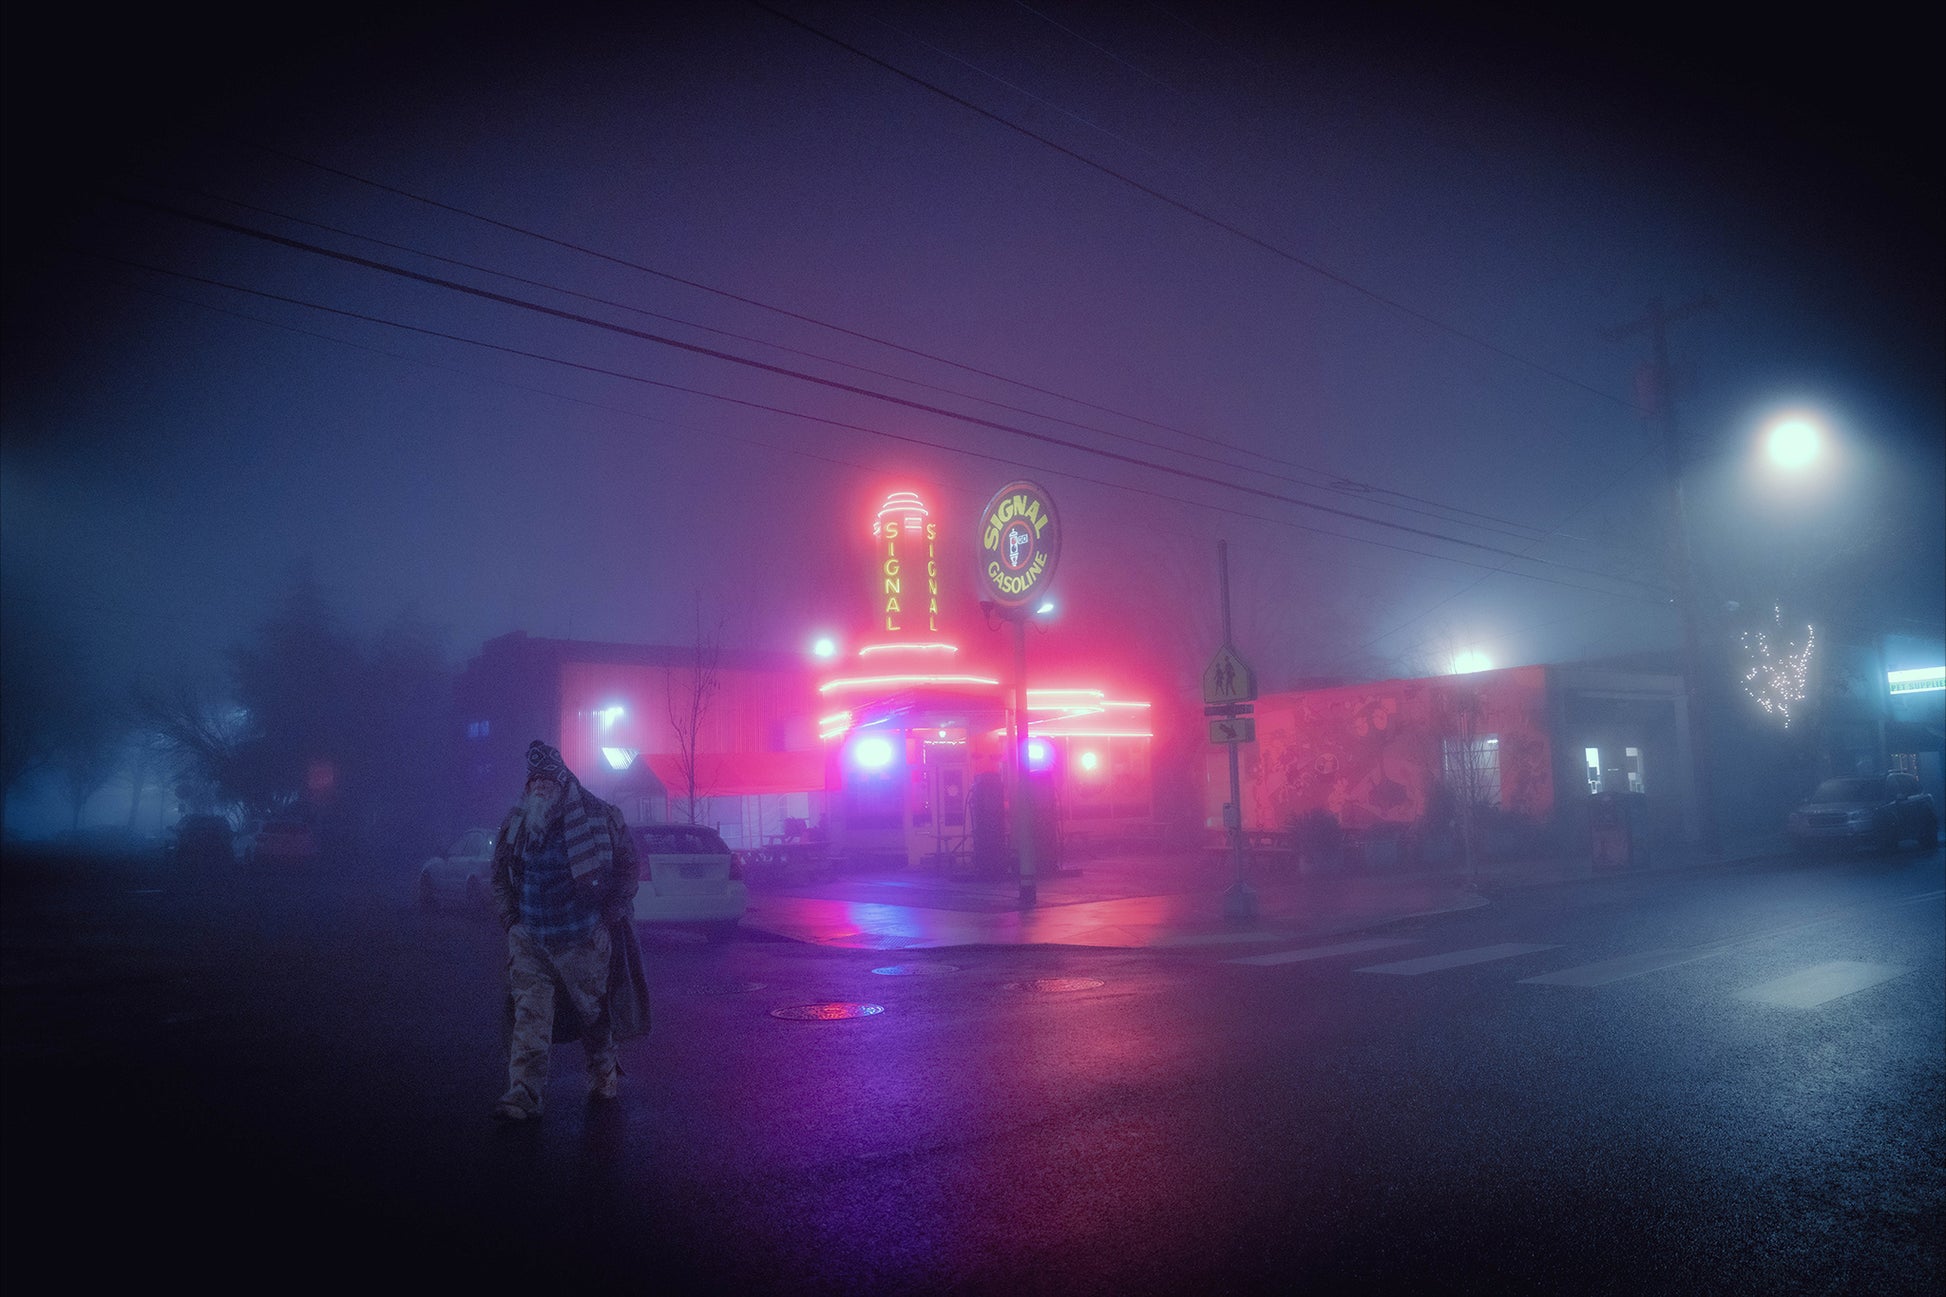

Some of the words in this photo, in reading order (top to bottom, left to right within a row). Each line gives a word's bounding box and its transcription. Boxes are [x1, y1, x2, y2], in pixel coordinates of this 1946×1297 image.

[985, 495, 1048, 550] SIGNAL
[885, 522, 901, 631] SIGNAL
[926, 523, 938, 631] SIGNAL
[988, 551, 1048, 593] GASOLINE
